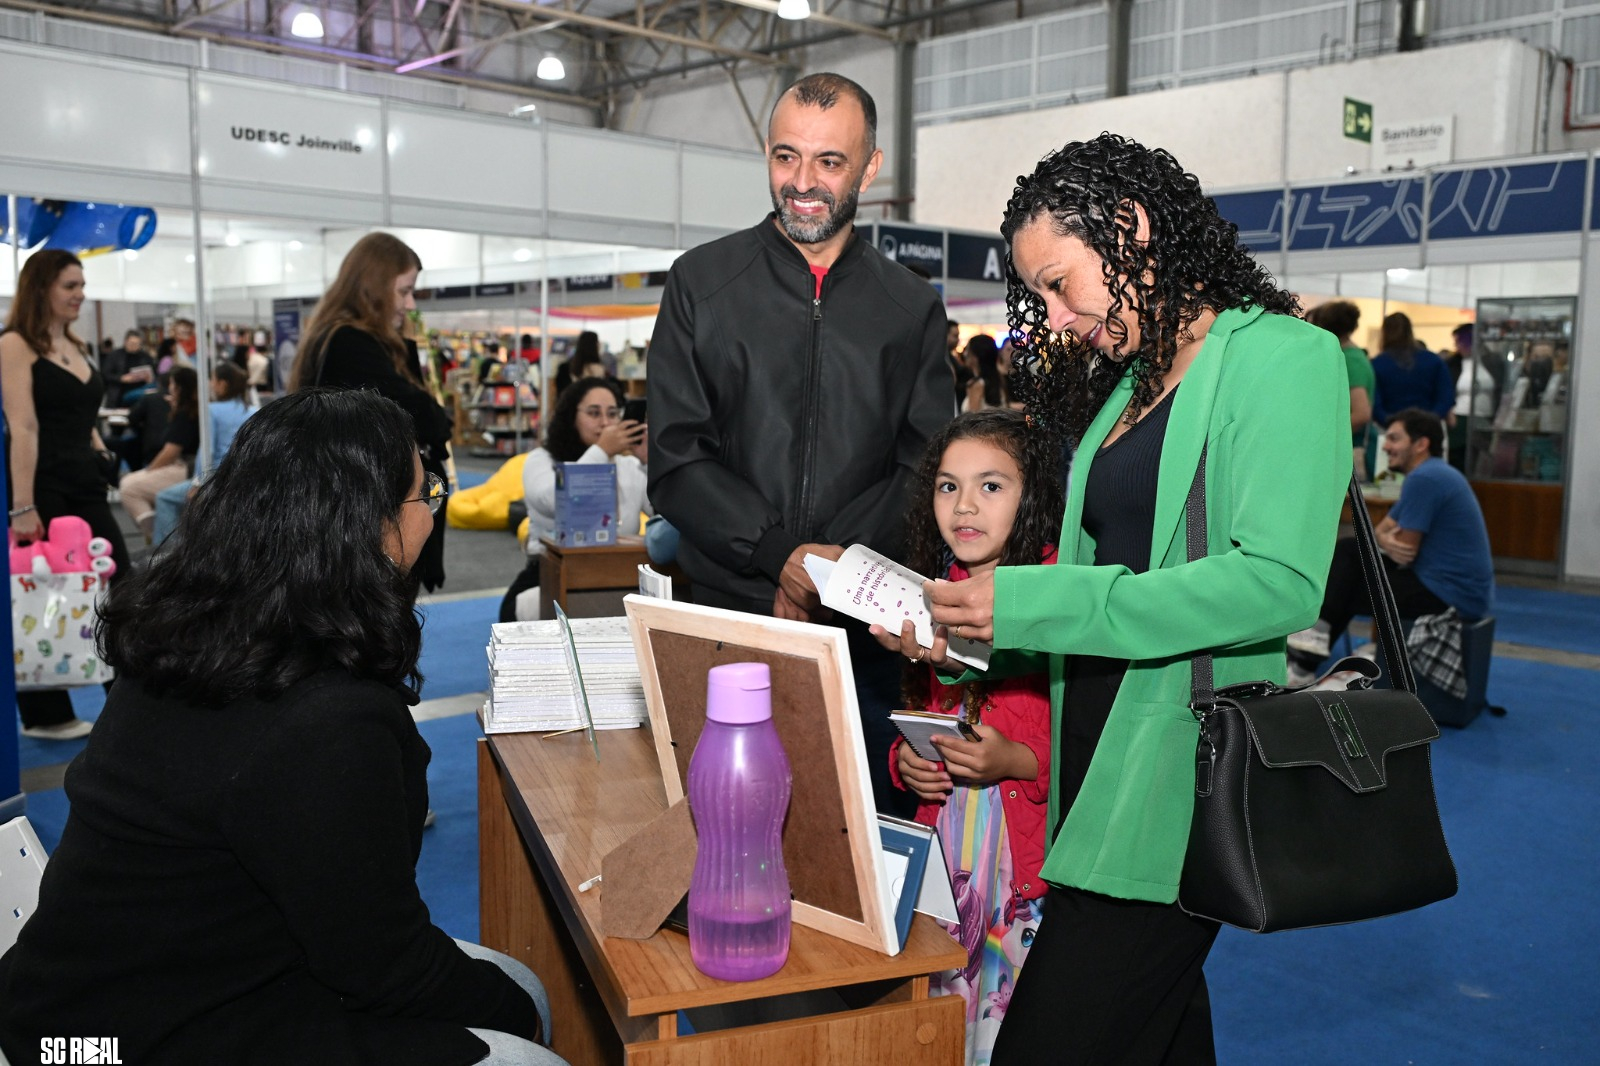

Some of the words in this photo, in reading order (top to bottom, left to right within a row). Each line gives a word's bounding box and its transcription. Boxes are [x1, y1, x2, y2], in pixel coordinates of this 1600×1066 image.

[231, 126, 290, 146] UDESC
[296, 134, 362, 154] Joinville
[982, 247, 1001, 280] A
[852, 586, 865, 605] Uma
[866, 591, 875, 602] de
